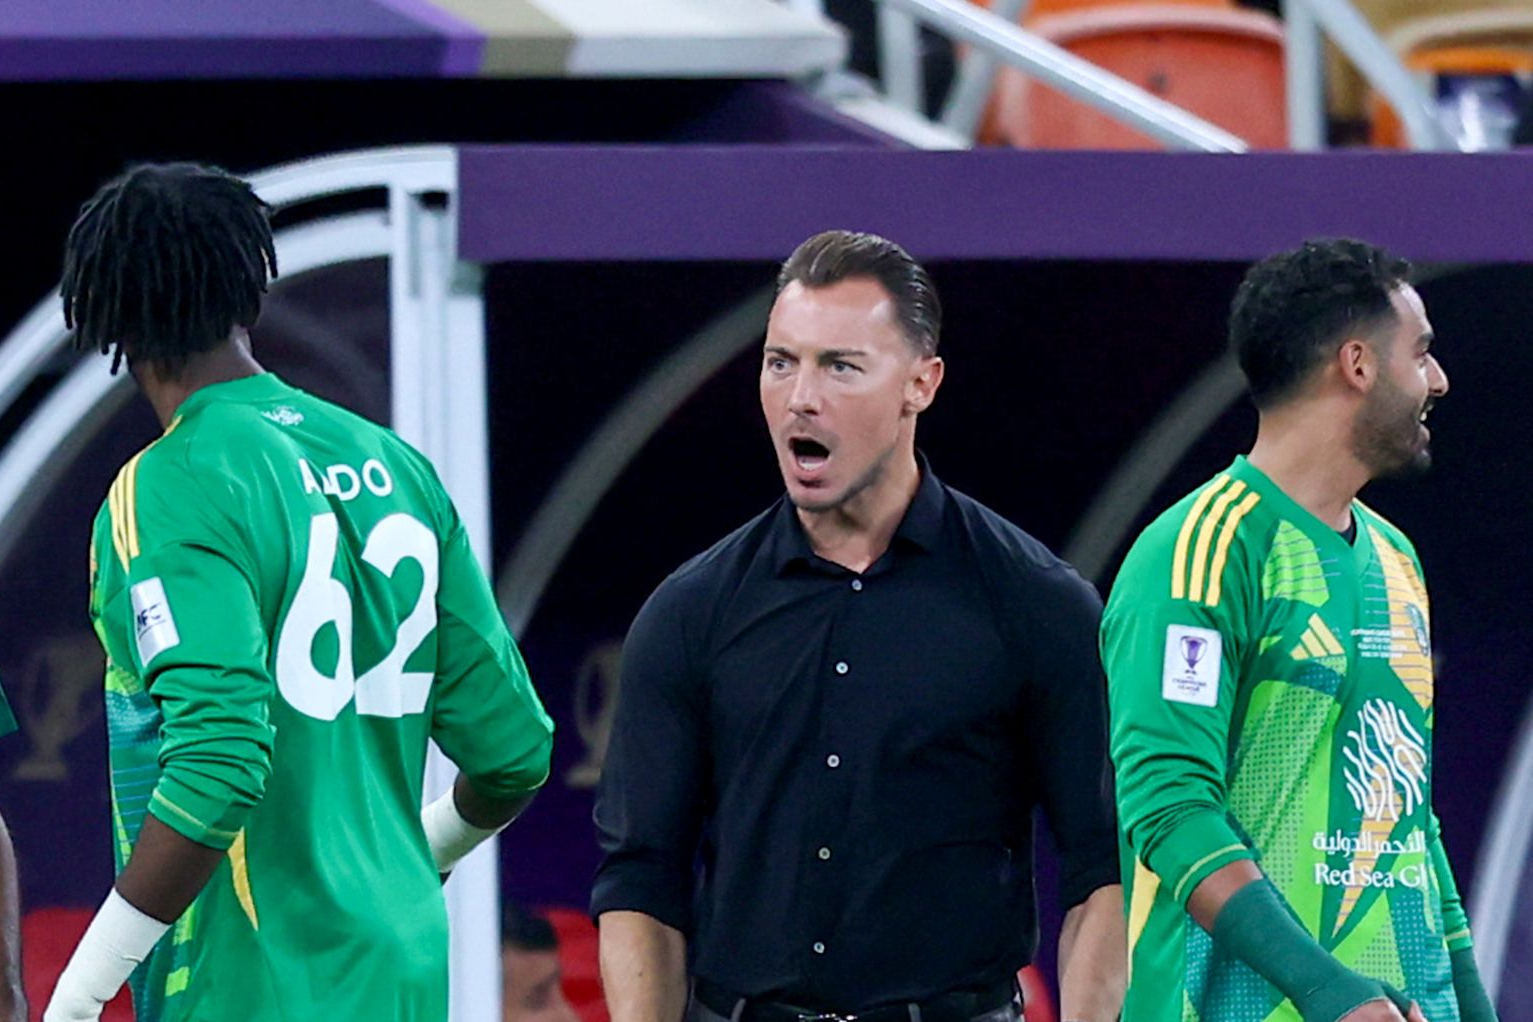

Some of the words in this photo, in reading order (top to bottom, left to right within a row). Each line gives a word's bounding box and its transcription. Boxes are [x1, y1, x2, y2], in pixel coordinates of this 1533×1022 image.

[276, 511, 439, 722] 62
[1314, 862, 1356, 886] Red
[1359, 865, 1395, 888] Sea
